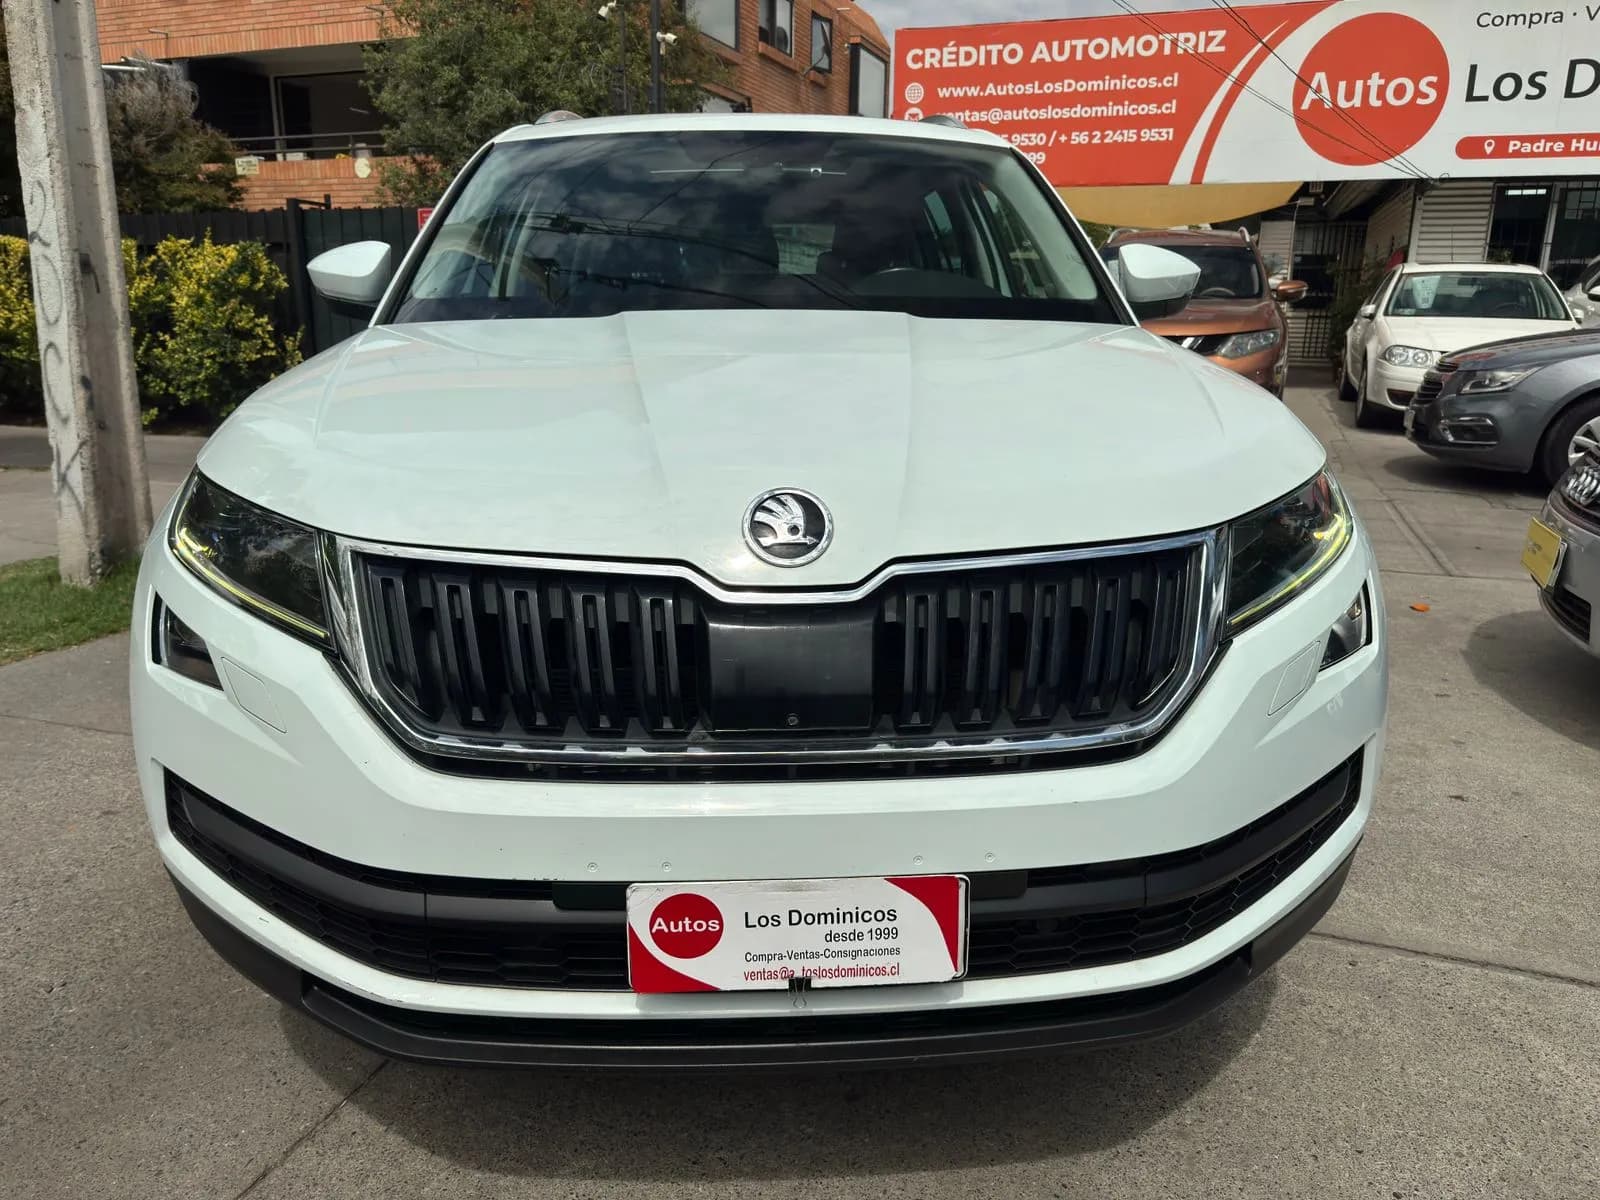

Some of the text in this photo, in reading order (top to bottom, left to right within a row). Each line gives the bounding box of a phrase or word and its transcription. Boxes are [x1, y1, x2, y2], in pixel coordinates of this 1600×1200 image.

[1476, 10, 1565, 28] Compra
[906, 30, 1227, 70] CRÉDITO AUTOMOTRIZ
[937, 72, 1179, 99] www.AutosLosDominicos.cl
[1300, 71, 1440, 111] Autos
[1464, 63, 1549, 103] Los
[1011, 132, 1046, 147] 9530
[1070, 131, 1089, 144] 56
[1091, 130, 1102, 143] 2
[1103, 128, 1137, 143] 2415
[1140, 127, 1174, 142] 9531
[1508, 138, 1564, 154] Padre
[651, 916, 721, 934] Autos
[743, 907, 898, 929] Los Dominicos
[824, 926, 899, 943] desde 1999
[744, 945, 901, 963] Compra-Ventas-Consignaciones
[743, 962, 900, 982] ventas@atoslosdominicos.cl
